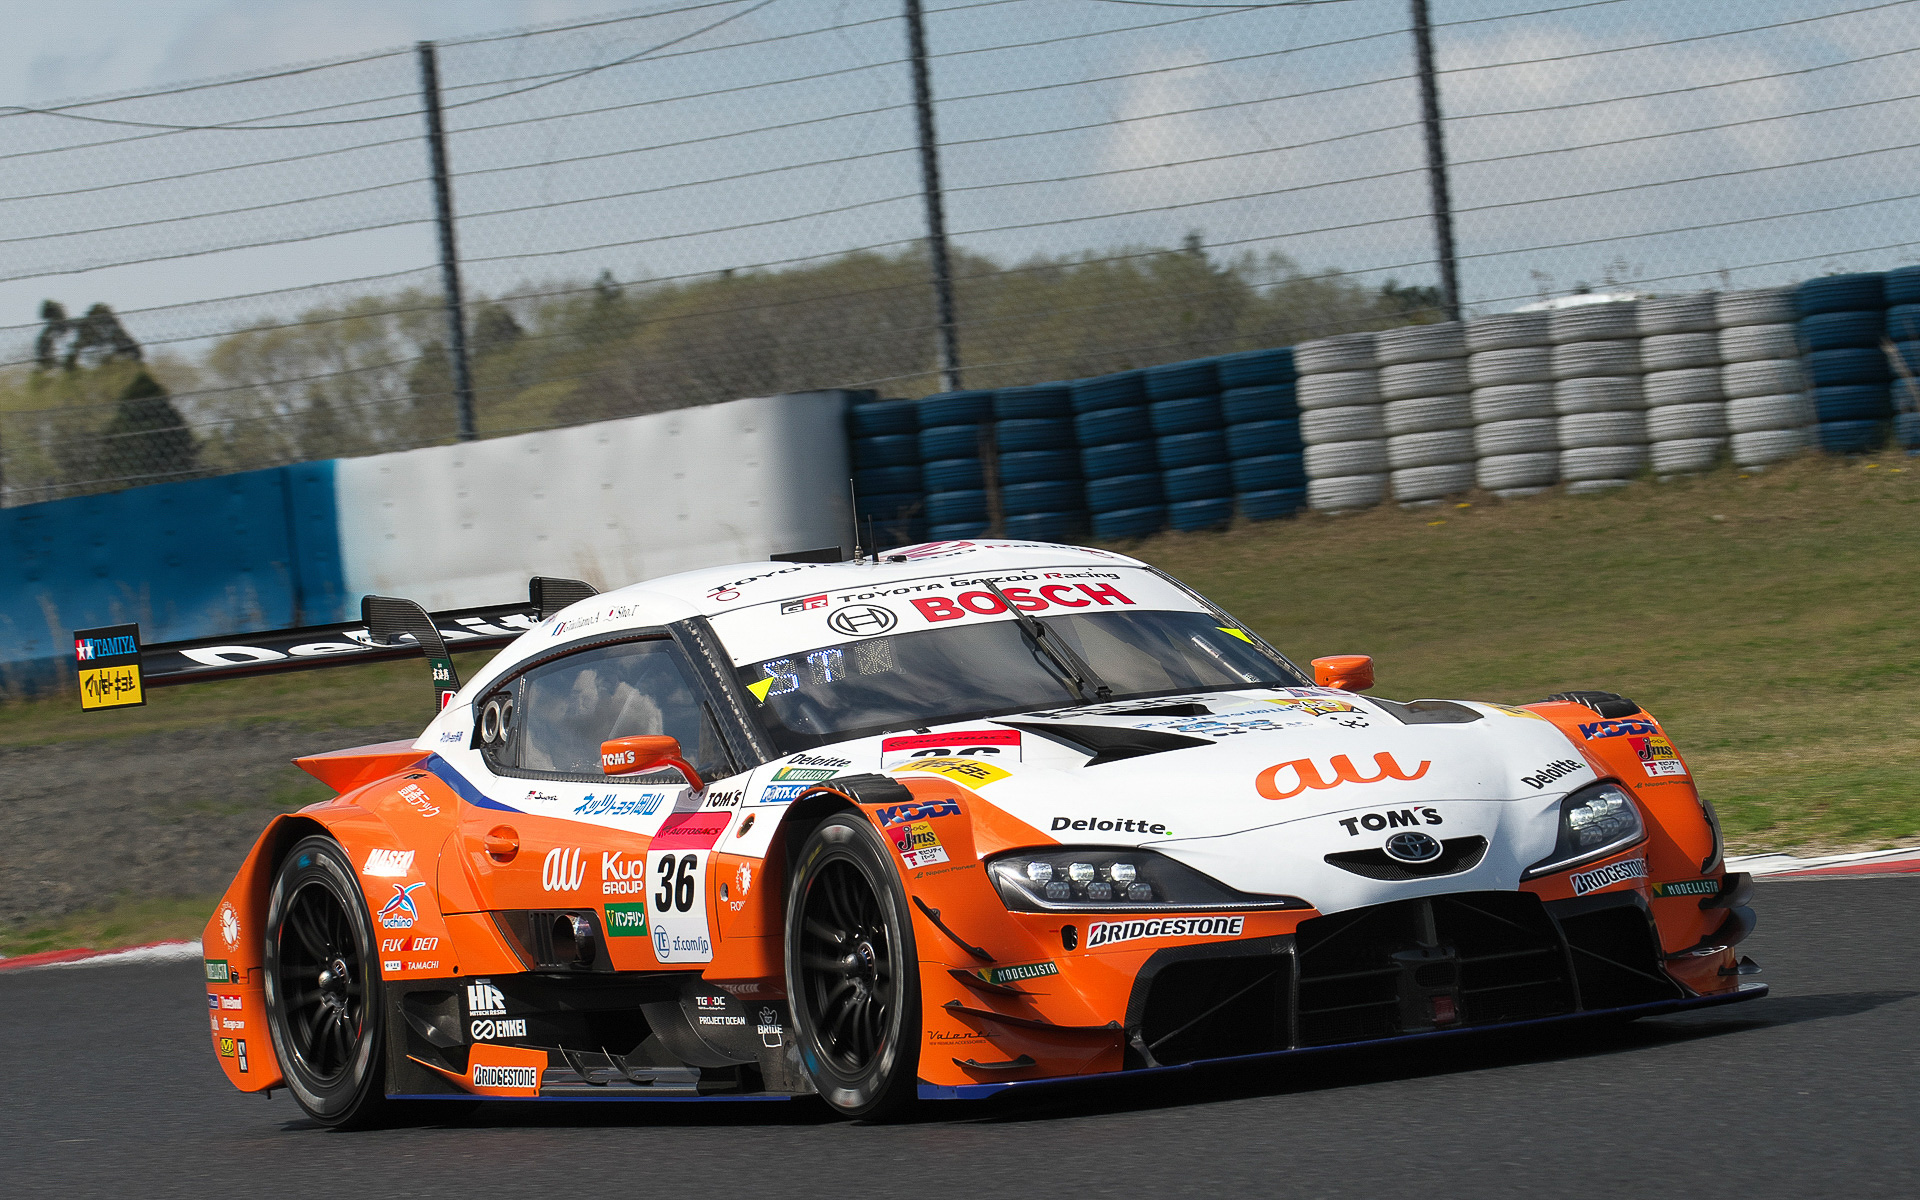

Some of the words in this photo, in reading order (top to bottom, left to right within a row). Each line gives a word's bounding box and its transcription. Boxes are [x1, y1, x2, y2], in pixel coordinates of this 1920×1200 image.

[837, 582, 944, 603] TOYOTA
[1043, 570, 1121, 580] Racing
[781, 595, 829, 615] GR
[909, 583, 1136, 622] BOSCH
[94, 635, 138, 658] TAMIYA
[1578, 718, 1659, 741] KDDI
[602, 750, 635, 766] TOM'S
[1638, 738, 1674, 760] jms
[785, 769, 834, 781] MODELLISTA
[1255, 751, 1432, 800] au
[573, 792, 665, 816] ネッツトヨタ岡山
[705, 790, 742, 808] TOM'S
[876, 798, 962, 827] KDDI
[1339, 806, 1443, 837] TOM'S
[669, 827, 721, 836] AUTOBACS
[896, 826, 936, 851] jms
[542, 847, 587, 892] au
[602, 880, 643, 895] GROUP
[655, 853, 698, 913] 36
[1667, 881, 1720, 896] MODELLISTA
[382, 914, 413, 928] uchino
[615, 911, 645, 927] バンテリン
[1088, 916, 1243, 948] BRIDGESTONE
[672, 936, 709, 954] zf.com/jp
[408, 961, 440, 971] TAMACHI
[997, 962, 1057, 982] MODELLISTA
[495, 1019, 527, 1037] ENKEI
[699, 1016, 724, 1025] PROJECT
[725, 1016, 745, 1025] OCEAN
[757, 1024, 784, 1035] BRIDE
[927, 1029, 1000, 1040] Valenti
[474, 1065, 536, 1086] BRIDGESTONE
